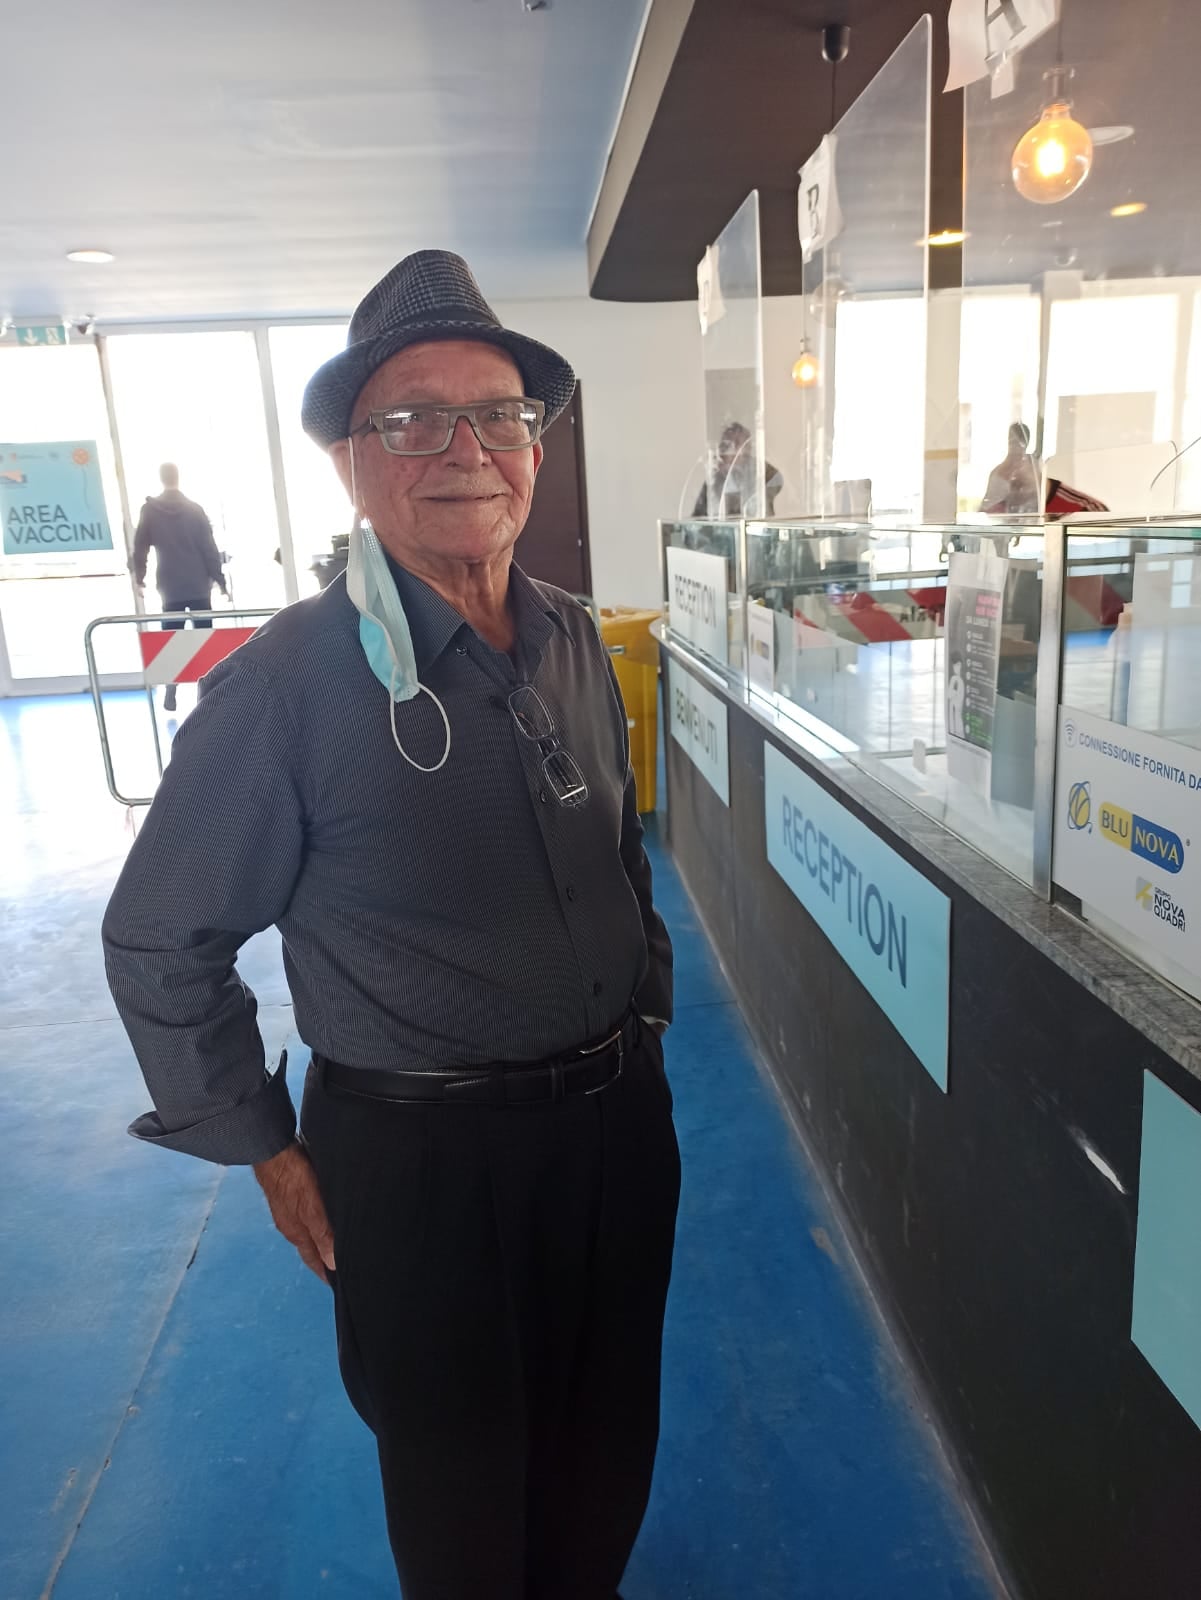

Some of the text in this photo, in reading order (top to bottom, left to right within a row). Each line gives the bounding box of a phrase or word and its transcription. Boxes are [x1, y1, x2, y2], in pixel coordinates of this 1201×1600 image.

[983, 0, 1027, 61] A
[7, 504, 69, 525] AREA
[8, 522, 104, 544] VACCINI
[1079, 732, 1141, 768] CONNESSIONE
[1142, 756, 1187, 786] FORNITA
[1101, 809, 1180, 866] BLU NOVA
[782, 793, 907, 989] RECEPTION
[1154, 893, 1186, 921] NOVA
[1153, 904, 1186, 933] QUADRI
